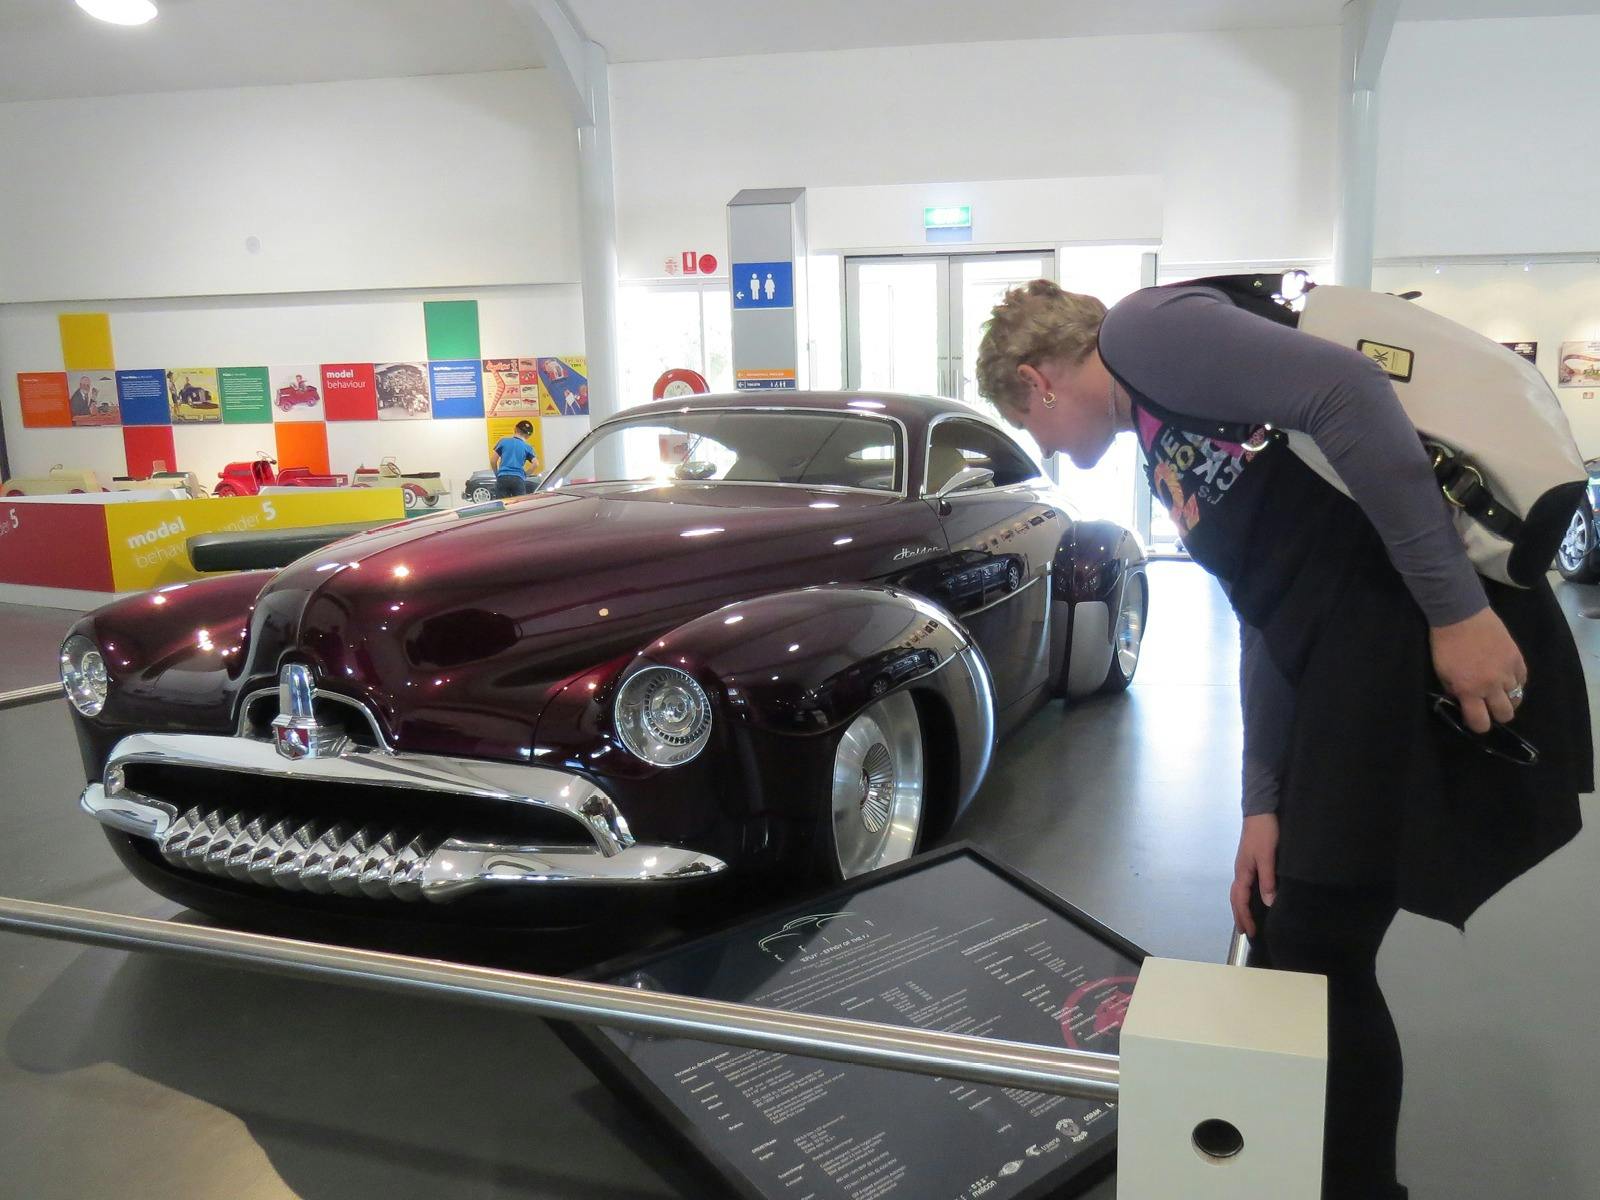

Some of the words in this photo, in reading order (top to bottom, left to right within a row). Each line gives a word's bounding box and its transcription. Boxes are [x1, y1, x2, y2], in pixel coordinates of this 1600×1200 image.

[326, 369, 354, 379] model
[327, 379, 367, 389] behaviour
[9, 508, 19, 529] 5
[217, 512, 261, 532] nder
[261, 500, 277, 522] 5
[127, 516, 186, 550] model
[136, 541, 188, 570] behav
[892, 546, 944, 561] Holden
